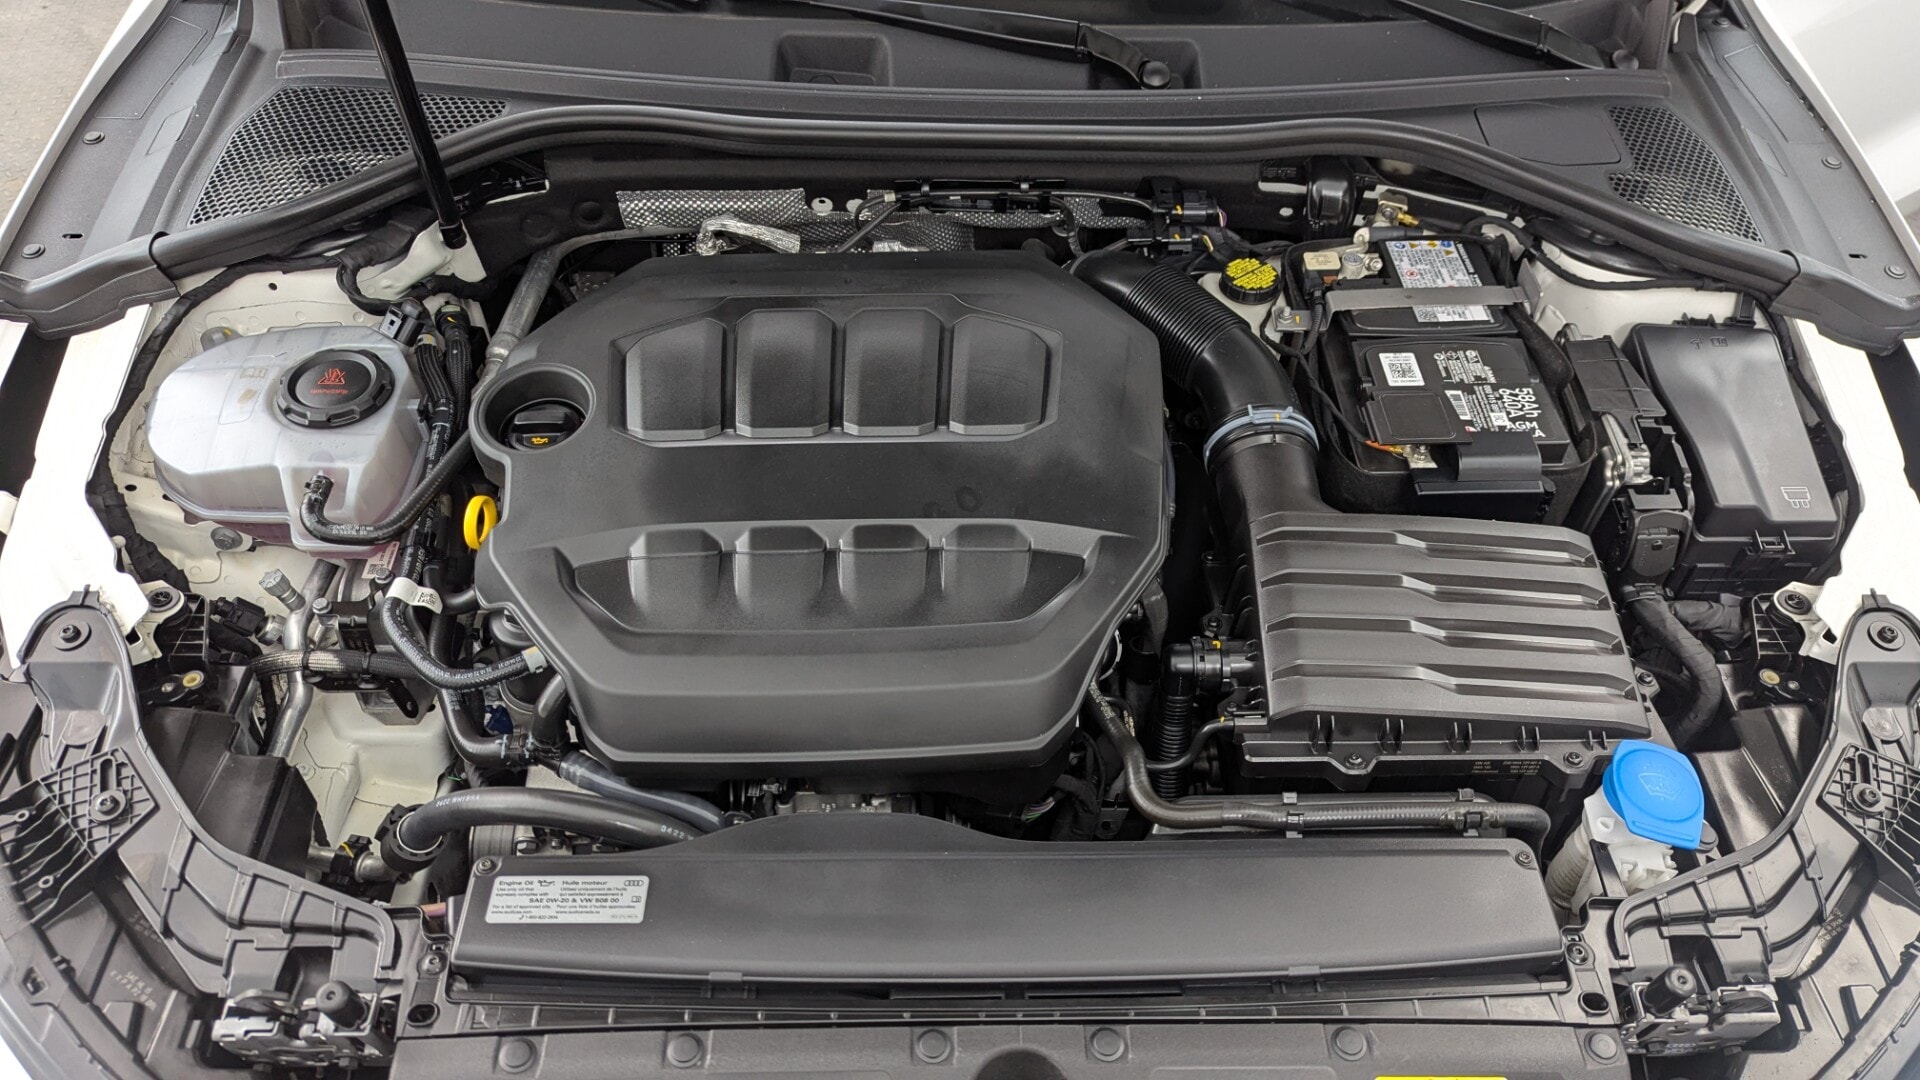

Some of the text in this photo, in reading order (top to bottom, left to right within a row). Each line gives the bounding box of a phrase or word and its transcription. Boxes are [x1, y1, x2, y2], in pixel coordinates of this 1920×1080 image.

[1499, 388, 1525, 417] 640A
[1519, 388, 1542, 417] 58Ah
[1506, 421, 1539, 429] AGM
